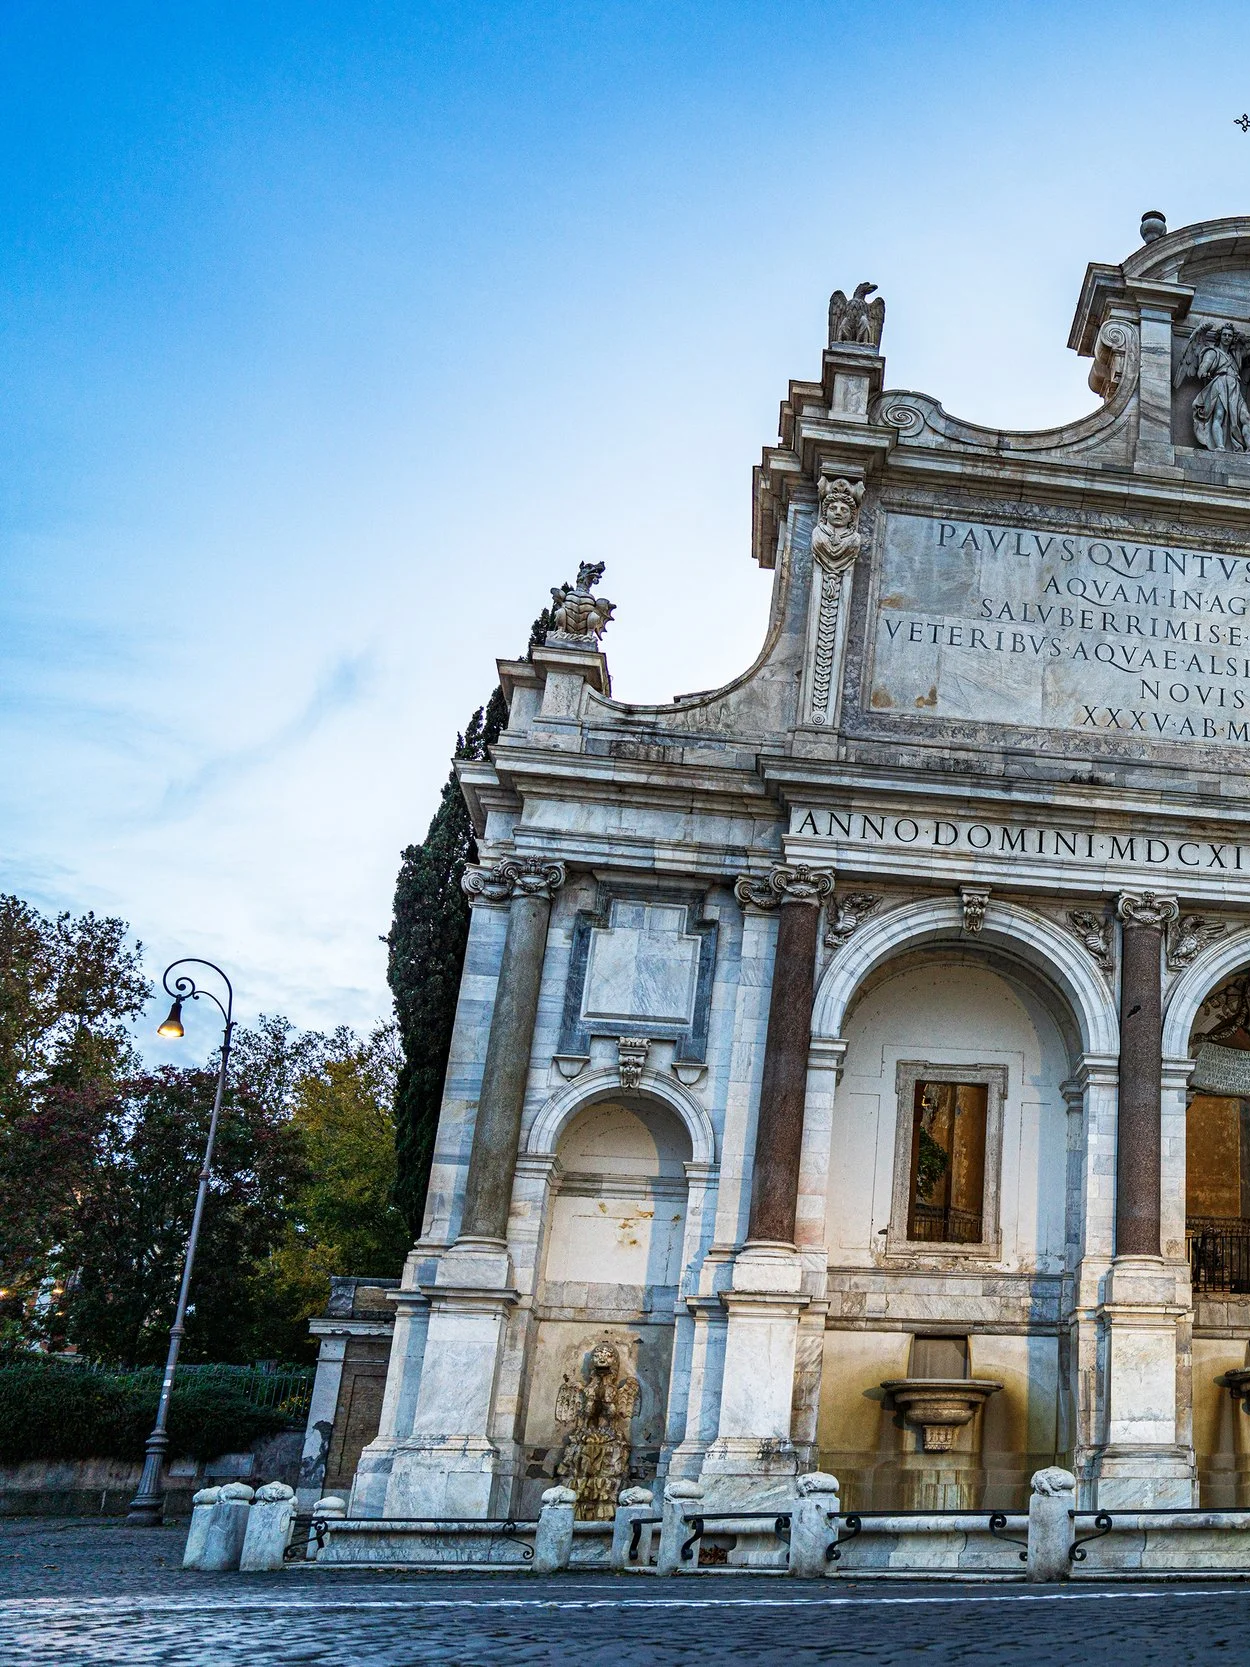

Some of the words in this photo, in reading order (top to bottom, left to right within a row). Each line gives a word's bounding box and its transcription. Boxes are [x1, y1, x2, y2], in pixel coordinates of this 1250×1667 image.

[936, 523, 1075, 563] PAVLVS
[1043, 575, 1158, 607] AQVAM
[1169, 589, 1201, 609] IN
[981, 598, 1220, 644] SALVBERRIMIS
[1228, 627, 1242, 646] E
[883, 619, 1061, 656] VETERIBVS
[1070, 643, 1177, 673] AQVAE
[1081, 705, 1170, 732] XXXV
[1178, 717, 1218, 738] AB
[795, 810, 919, 842] ANNO
[932, 821, 1096, 857] DOMINI
